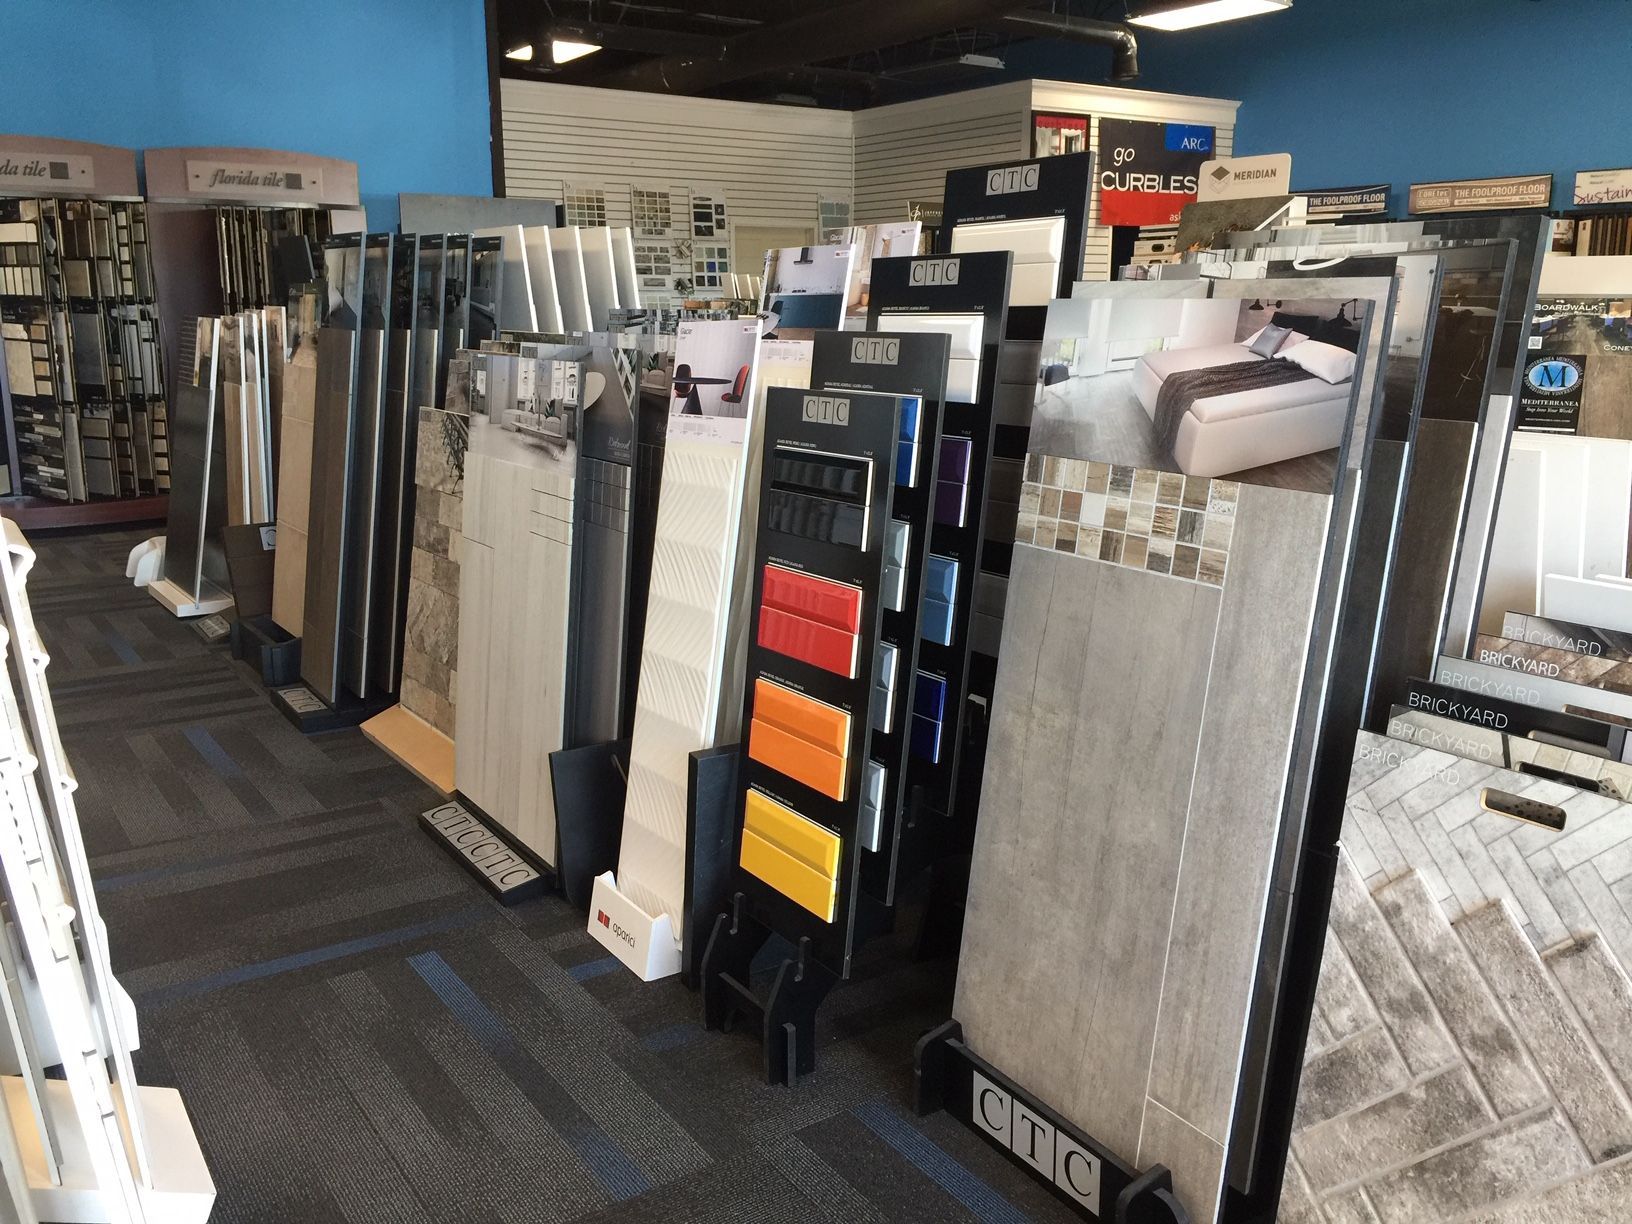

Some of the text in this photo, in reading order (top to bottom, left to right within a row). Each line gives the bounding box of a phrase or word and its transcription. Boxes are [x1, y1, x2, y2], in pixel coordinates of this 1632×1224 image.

[1181, 138, 1207, 151] ARC
[1113, 147, 1135, 166] go
[22, 161, 47, 177] tile
[209, 169, 283, 187] florida tile
[989, 168, 1037, 191] CTC
[1233, 168, 1277, 181] MERIDIAN
[1101, 171, 1199, 194] CURBLES
[1455, 184, 1546, 198] THE FOOLPROOF FLOOR
[1310, 193, 1386, 205] THE FOOLPROOF FLOOR
[912, 262, 957, 282] CTC
[1535, 303, 1599, 311] BOARDWALK
[854, 340, 898, 362] CTC
[1538, 365, 1570, 387] M
[805, 399, 847, 422] CTC
[1521, 398, 1579, 407] MEDITERRANEA
[1503, 625, 1602, 657] BRICKYARD
[1480, 649, 1560, 677] BRICKYARD
[1440, 670, 1540, 705] BRICKYARD
[1408, 691, 1509, 729] BRICKYARD
[1390, 720, 1493, 760] BRICKYARD
[612, 922, 636, 949] aparici
[979, 1088, 1093, 1197] CTC
